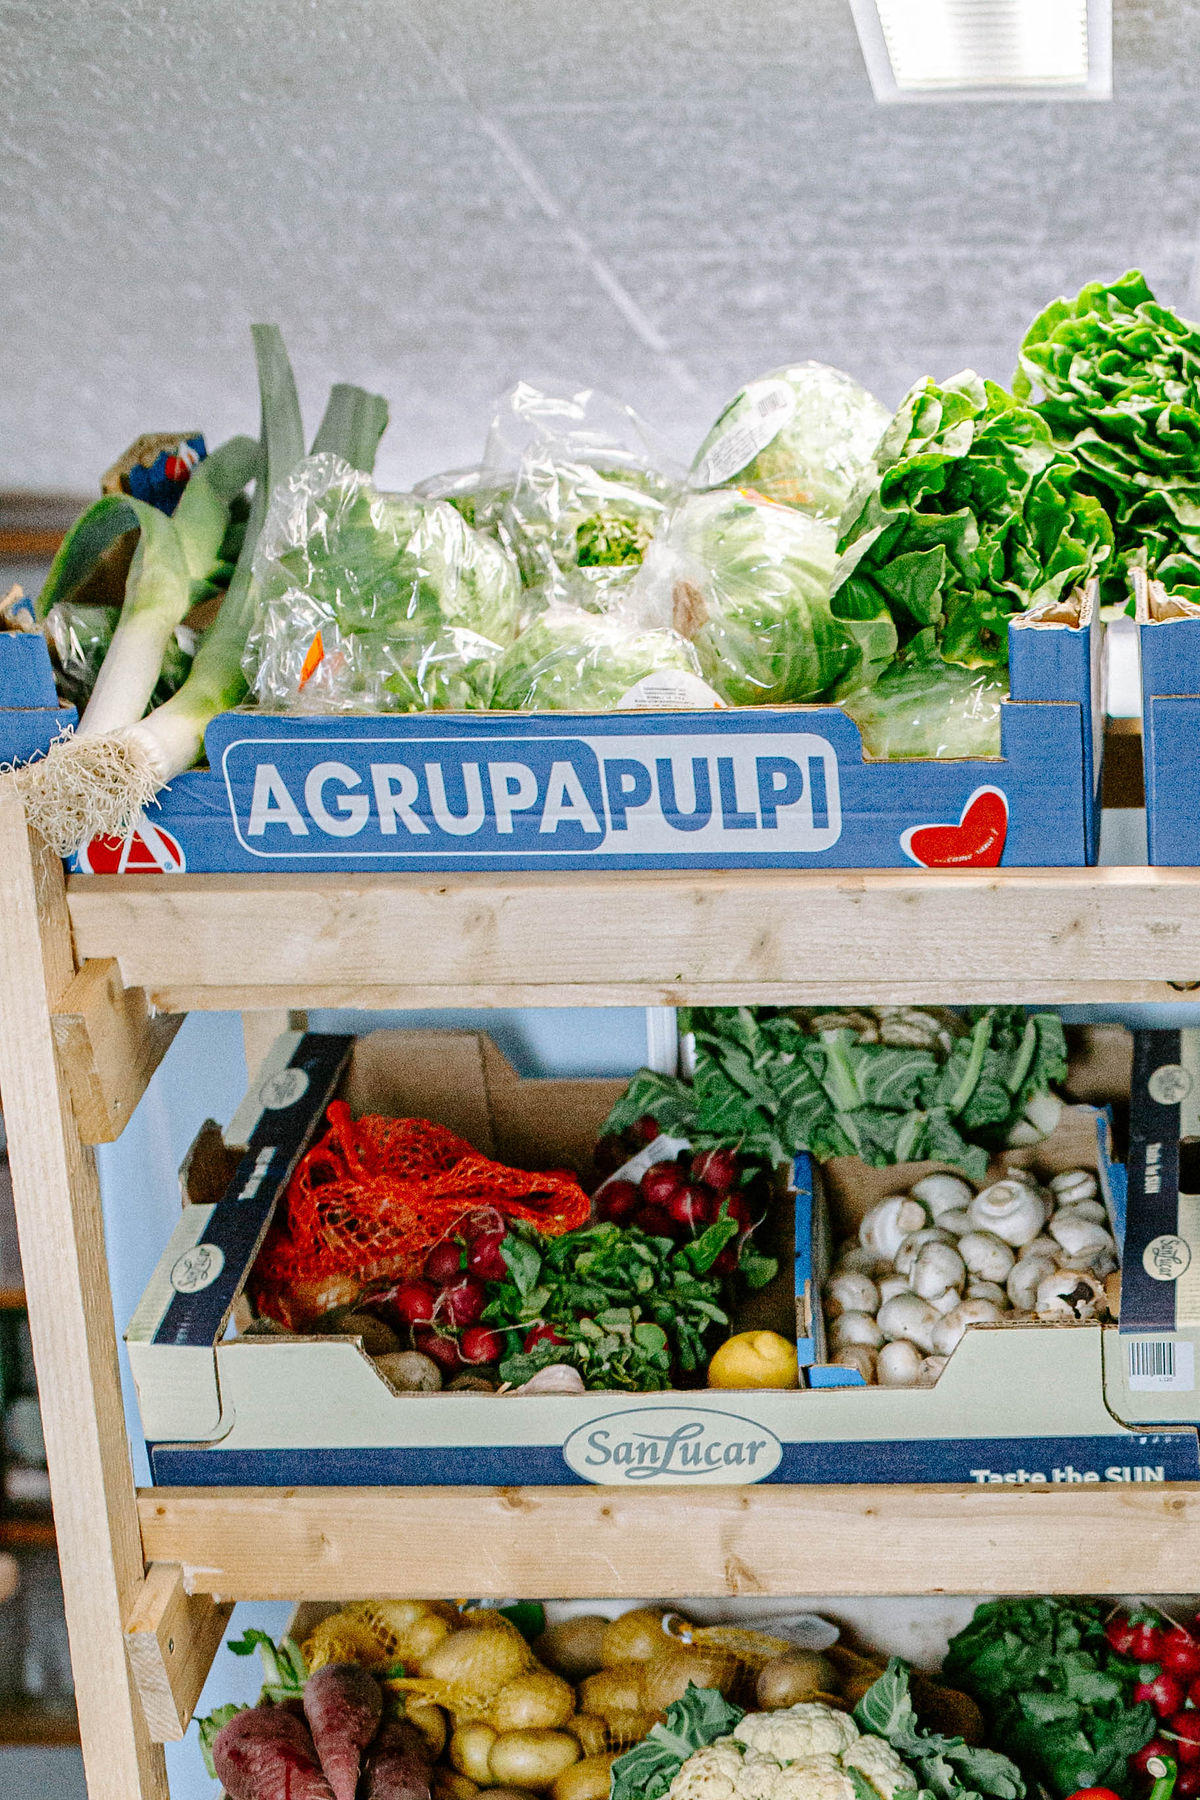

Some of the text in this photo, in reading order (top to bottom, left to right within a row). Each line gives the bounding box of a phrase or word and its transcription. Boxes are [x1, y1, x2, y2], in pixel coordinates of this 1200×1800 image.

[1152, 1239, 1182, 1278] SanLucar
[585, 1422, 767, 1480] SanLucar
[1104, 1465, 1165, 1482] SUN
